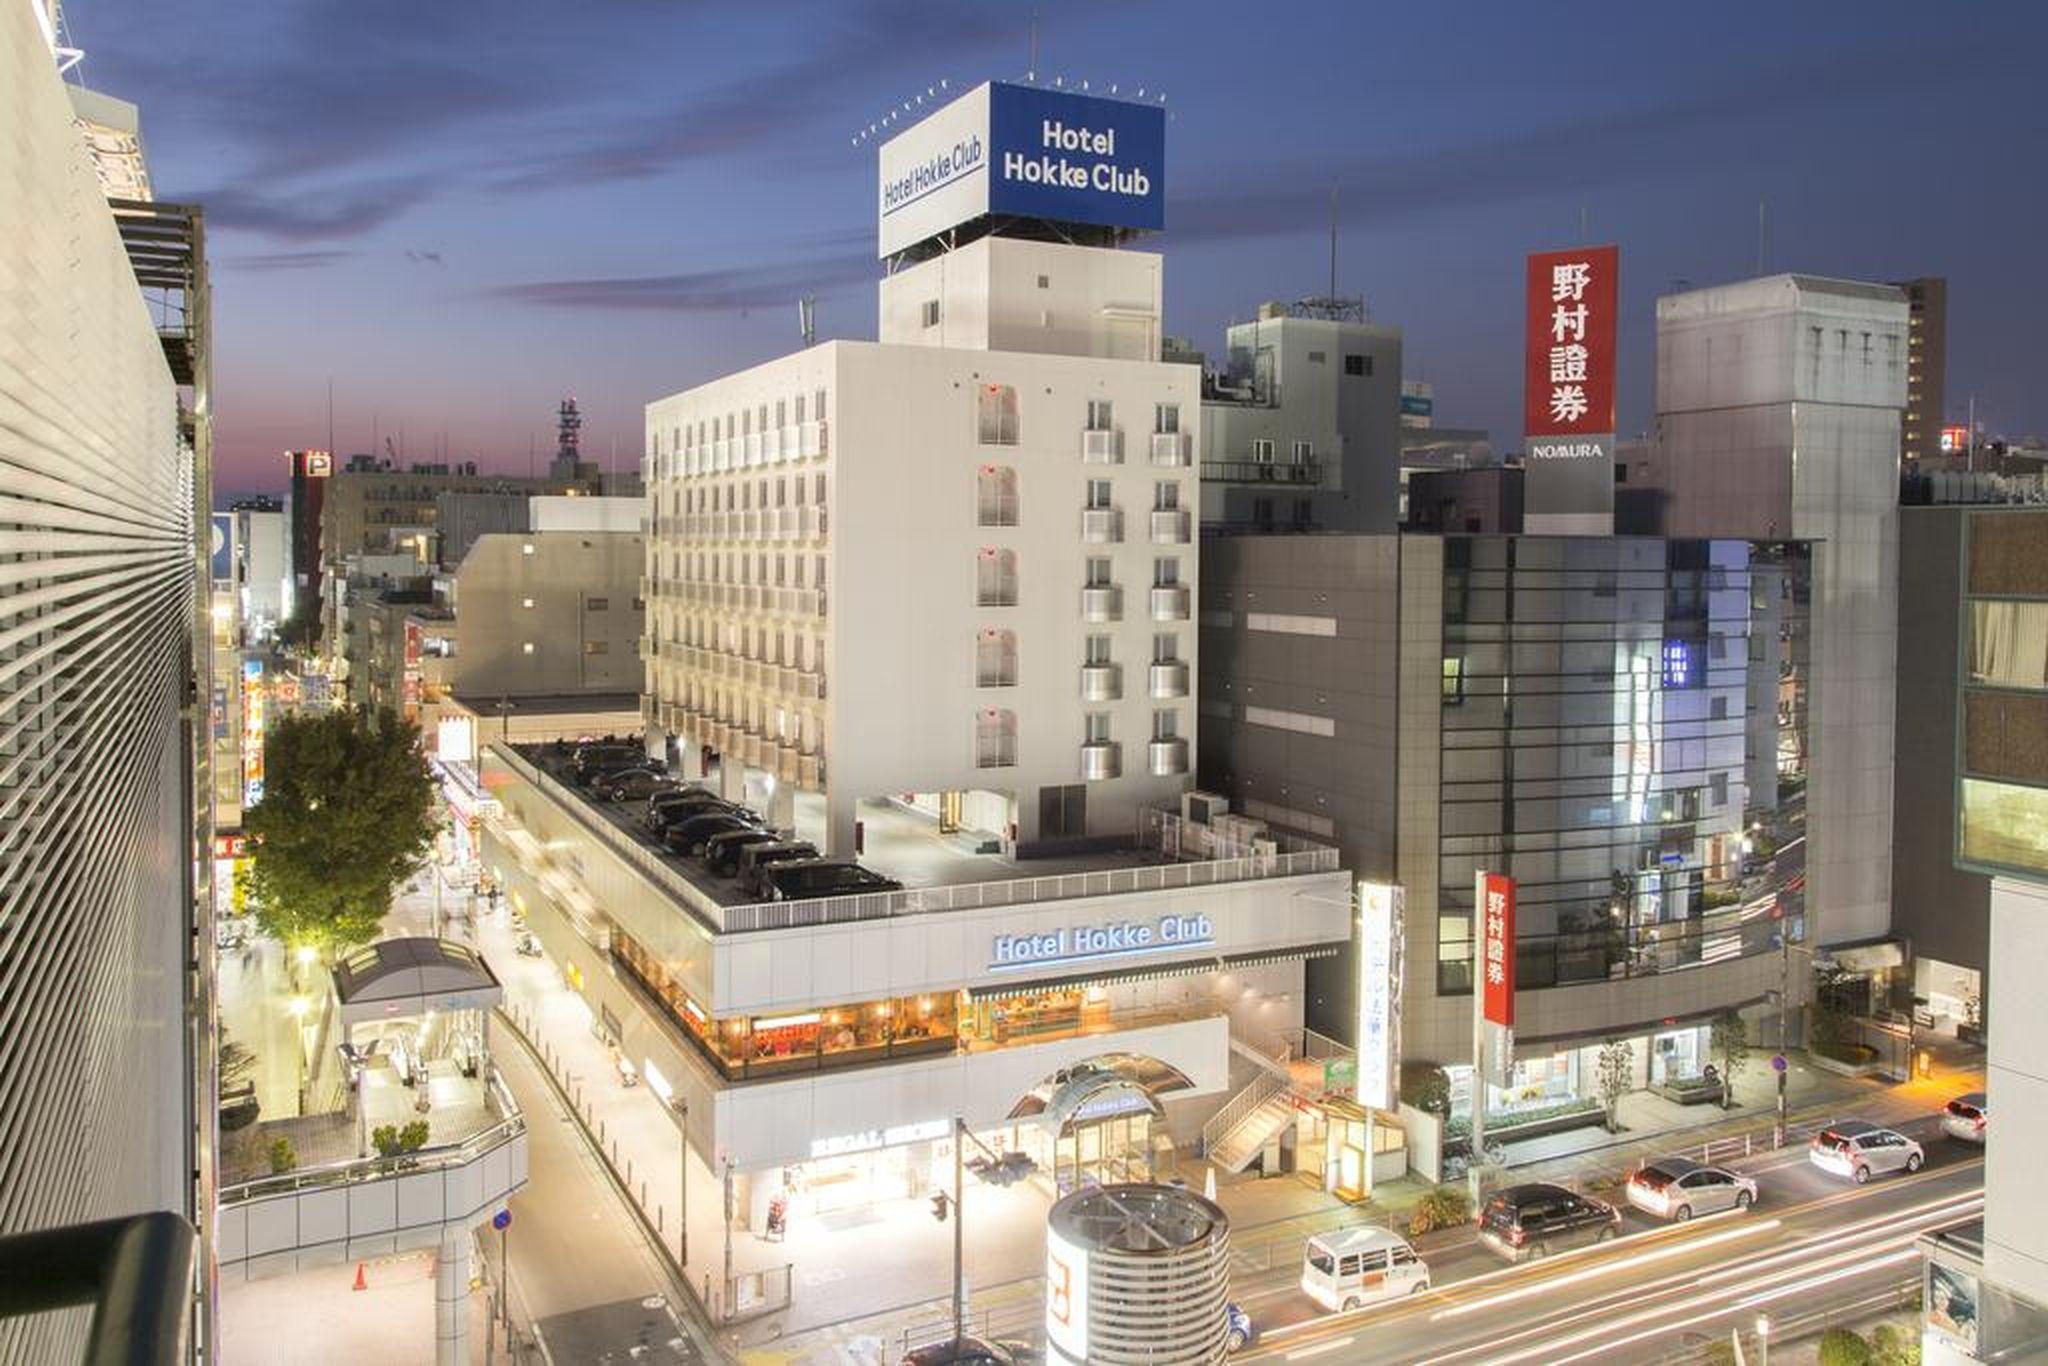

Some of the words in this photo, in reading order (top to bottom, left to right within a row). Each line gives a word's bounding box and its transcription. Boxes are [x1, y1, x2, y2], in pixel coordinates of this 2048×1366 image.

[1043, 120, 1114, 156] Hotel
[884, 171, 914, 208] Hotel
[912, 155, 951, 190] Hokke
[952, 134, 981, 172] Club
[1004, 153, 1088, 189] Hokke
[1092, 164, 1150, 197] Club
[1550, 262, 1591, 423] 野村證券
[1533, 443, 1603, 459] NOMURA
[995, 931, 1064, 961] Hotel
[1075, 923, 1151, 952] Hokke
[1161, 914, 1213, 942] Club
